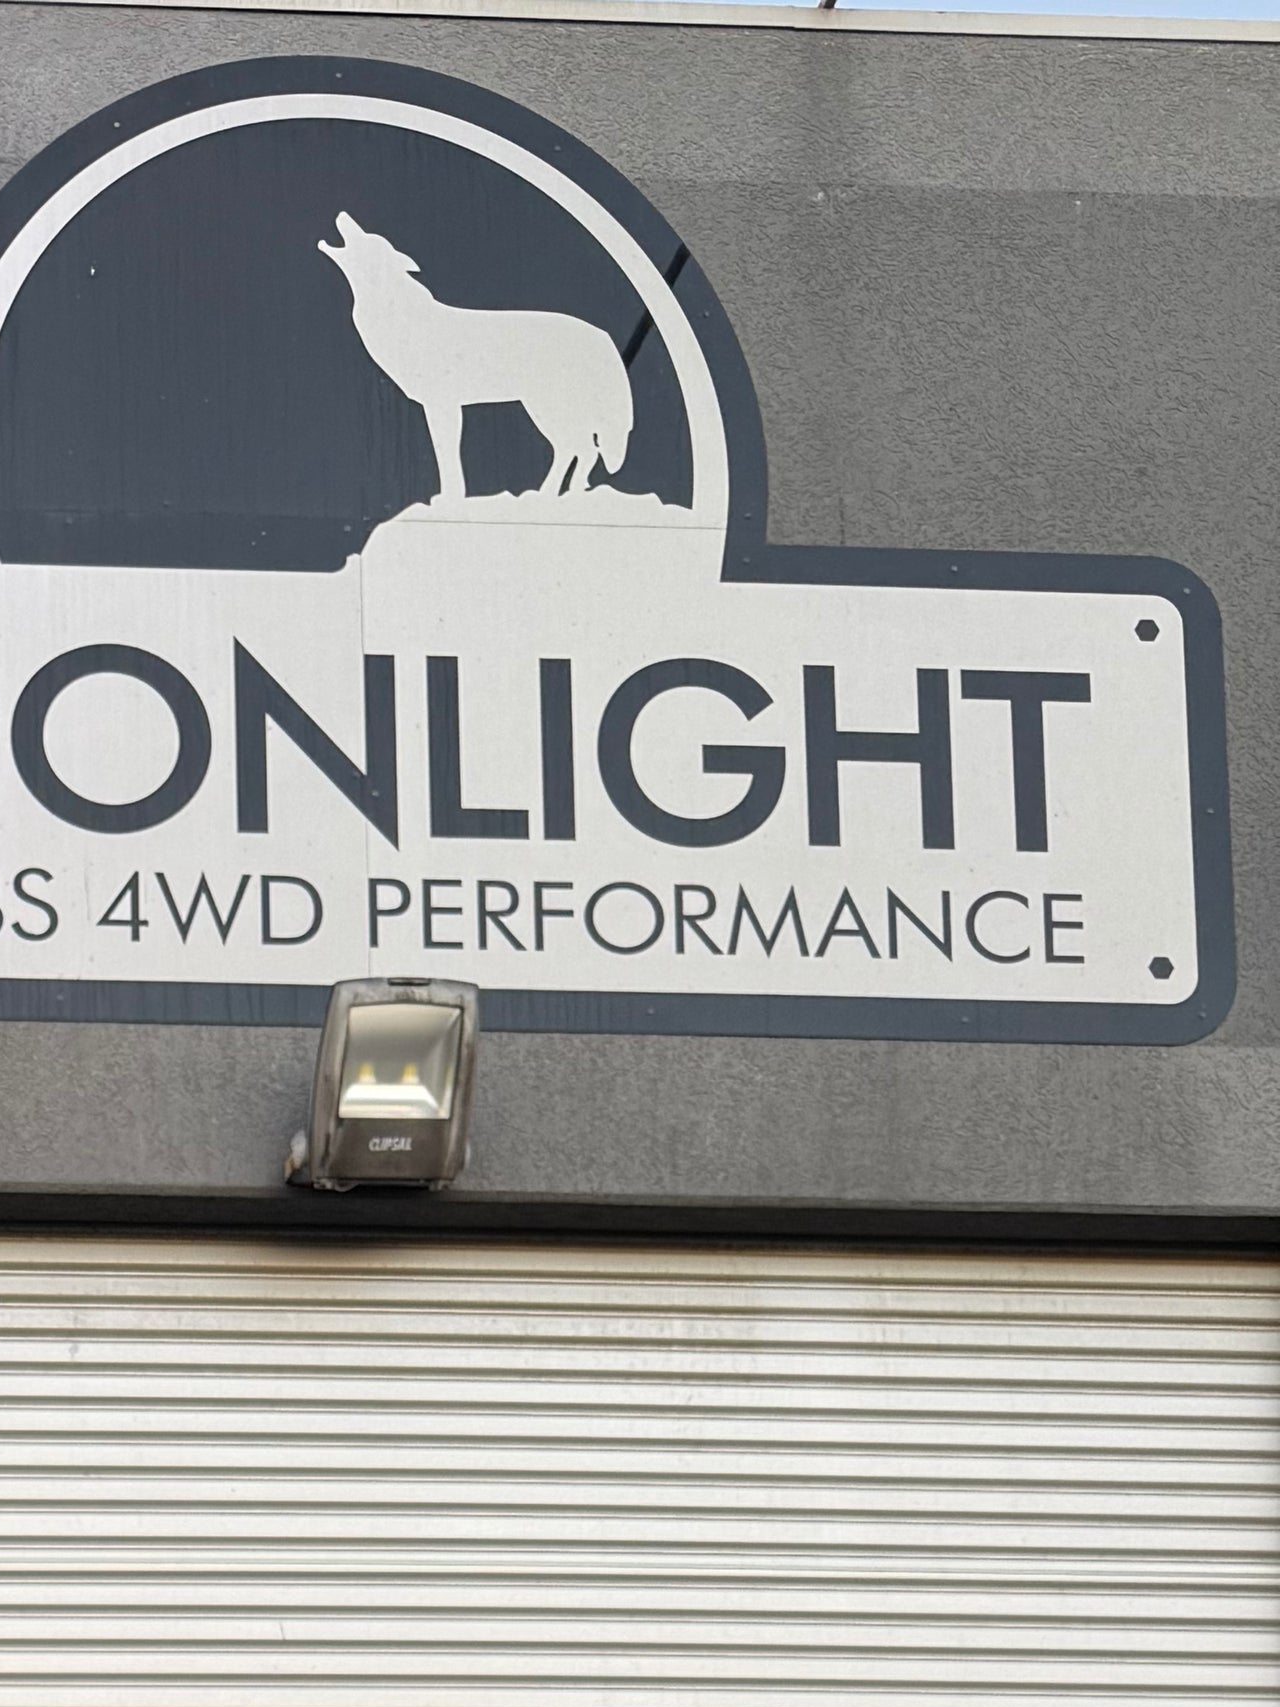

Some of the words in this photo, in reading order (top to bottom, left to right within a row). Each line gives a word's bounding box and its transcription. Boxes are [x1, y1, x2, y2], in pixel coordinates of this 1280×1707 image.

[97, 871, 324, 945] 4WD
[368, 878, 1086, 964] PERFORMANCE
[368, 1137, 413, 1151] CLIPSAL
